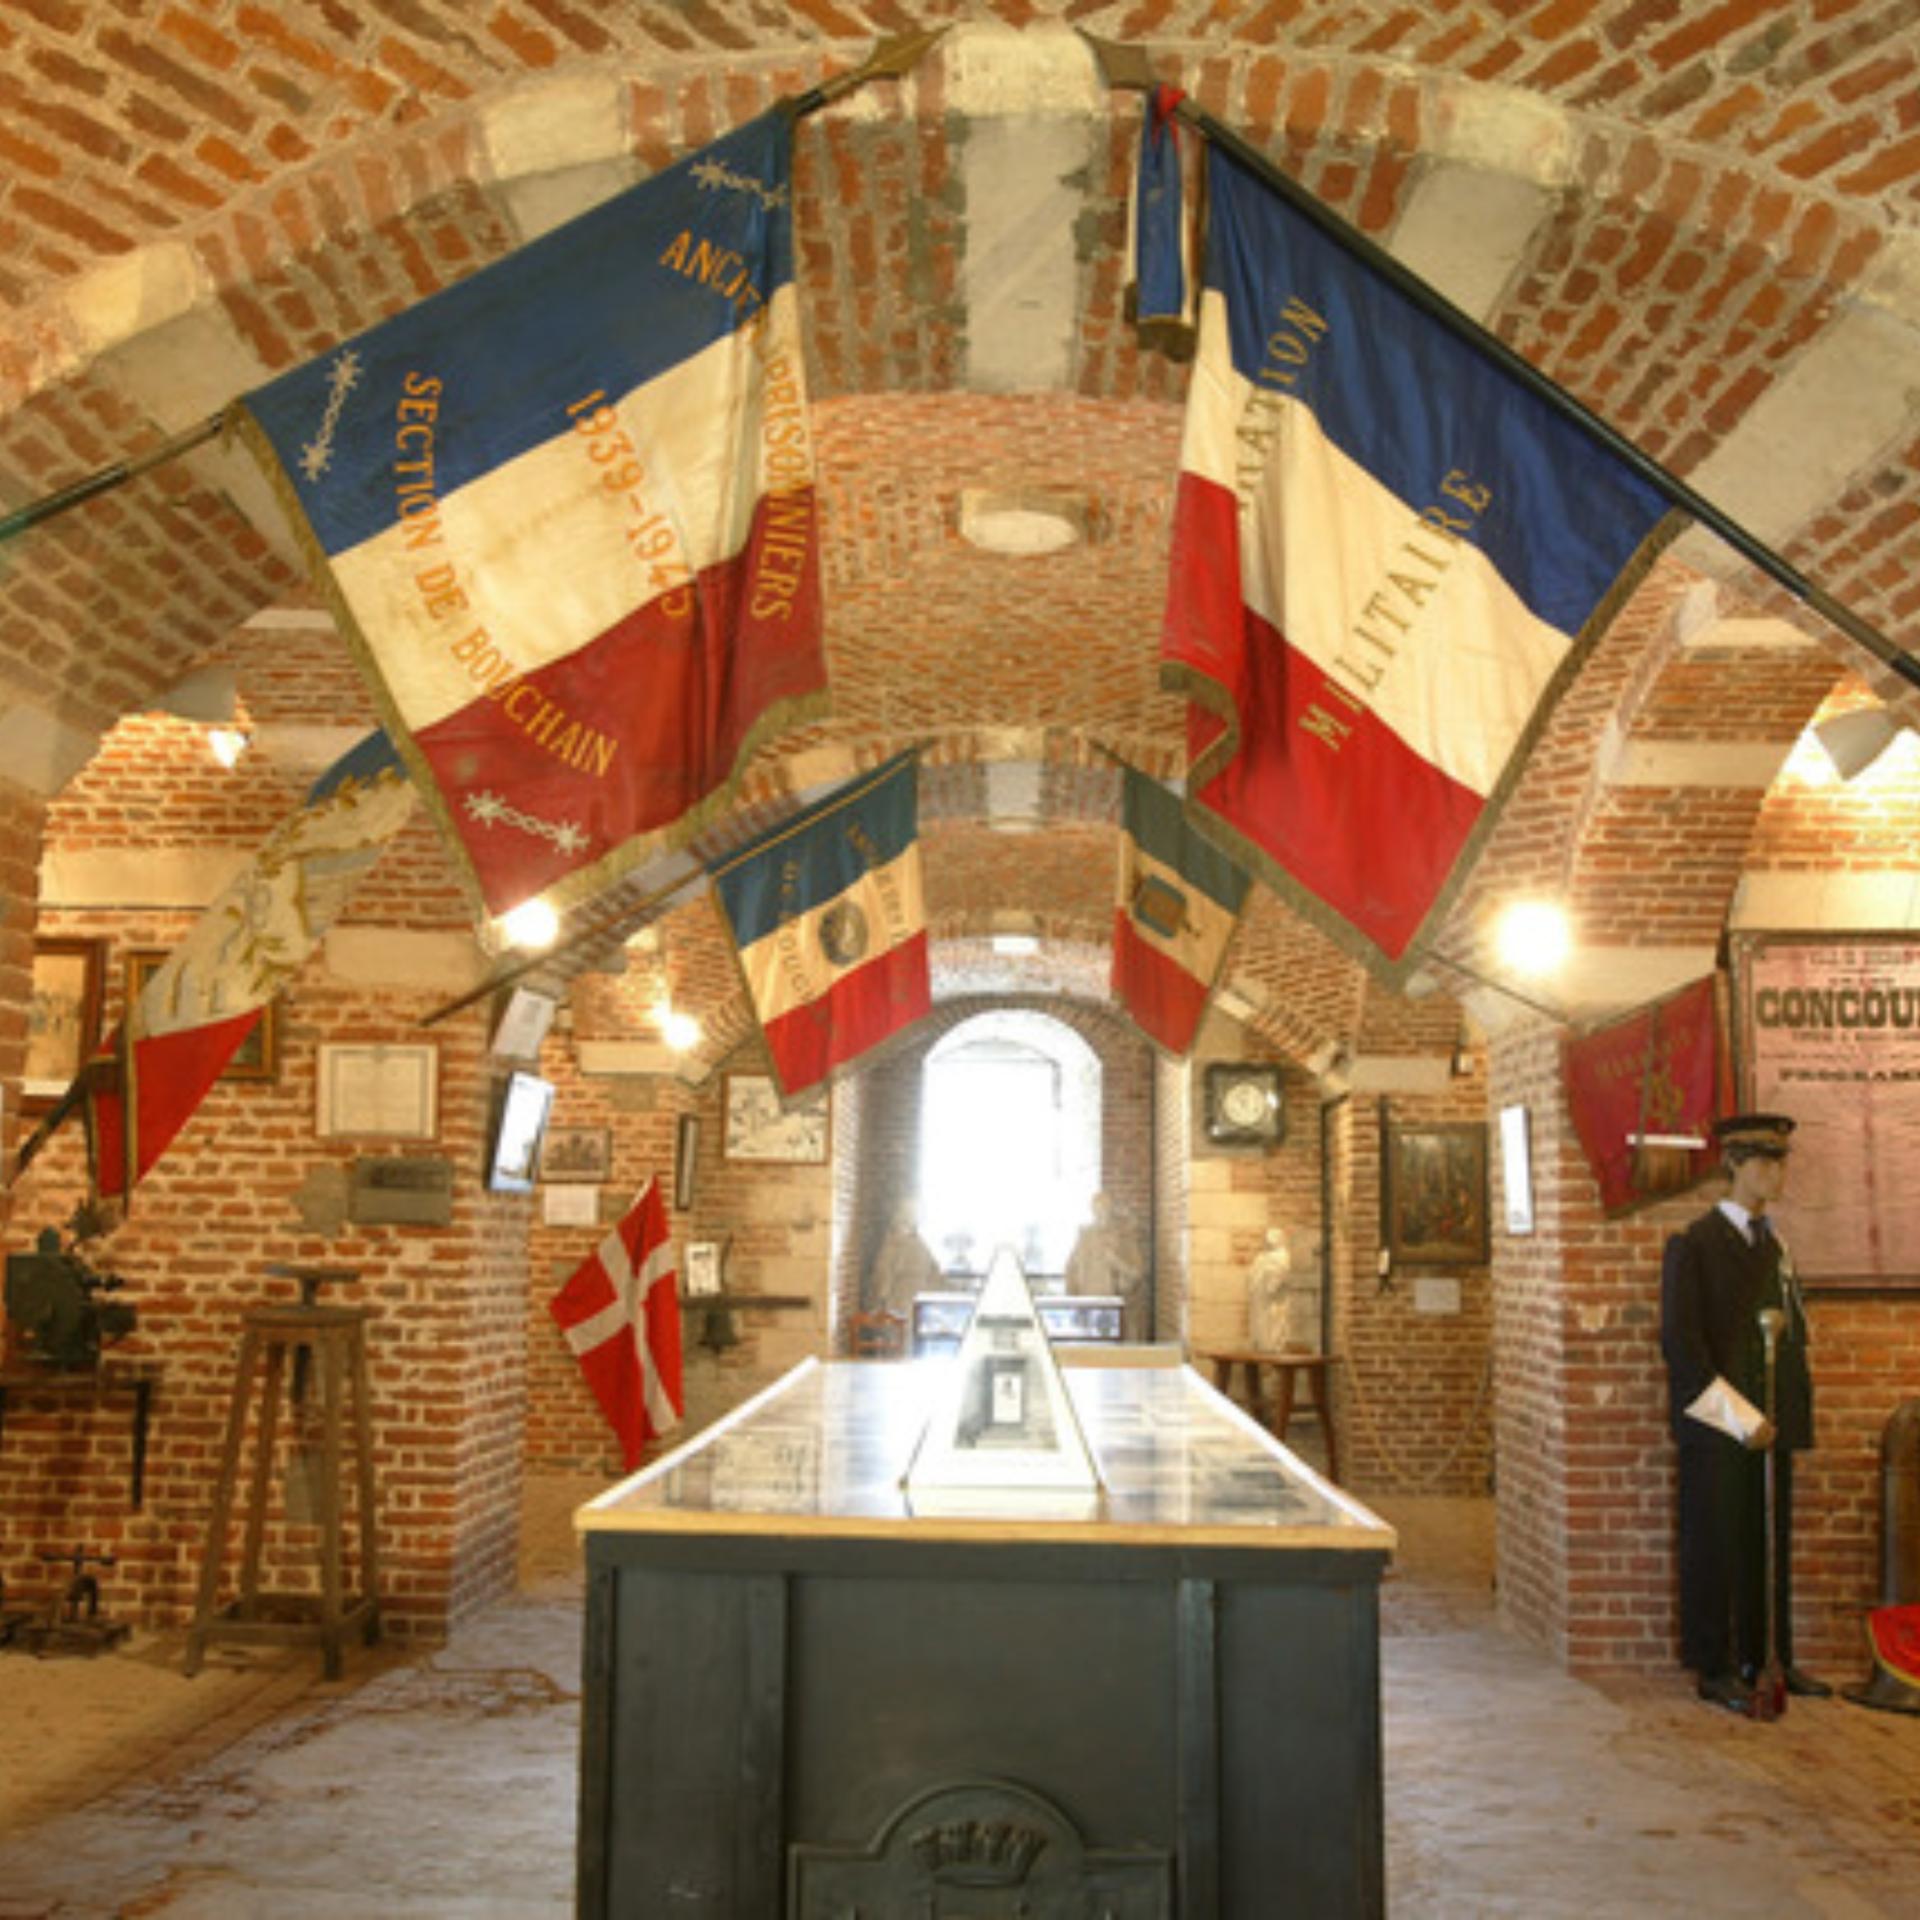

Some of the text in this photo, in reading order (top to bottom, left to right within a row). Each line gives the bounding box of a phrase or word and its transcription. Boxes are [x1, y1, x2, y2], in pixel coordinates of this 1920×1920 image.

[394, 371, 619, 778] SECTION DE BOUCHAIN
[566, 389, 692, 617] 1939-1945
[1298, 470, 1492, 753] MILITAIRE
[1756, 987, 1920, 1029] CONCOU
